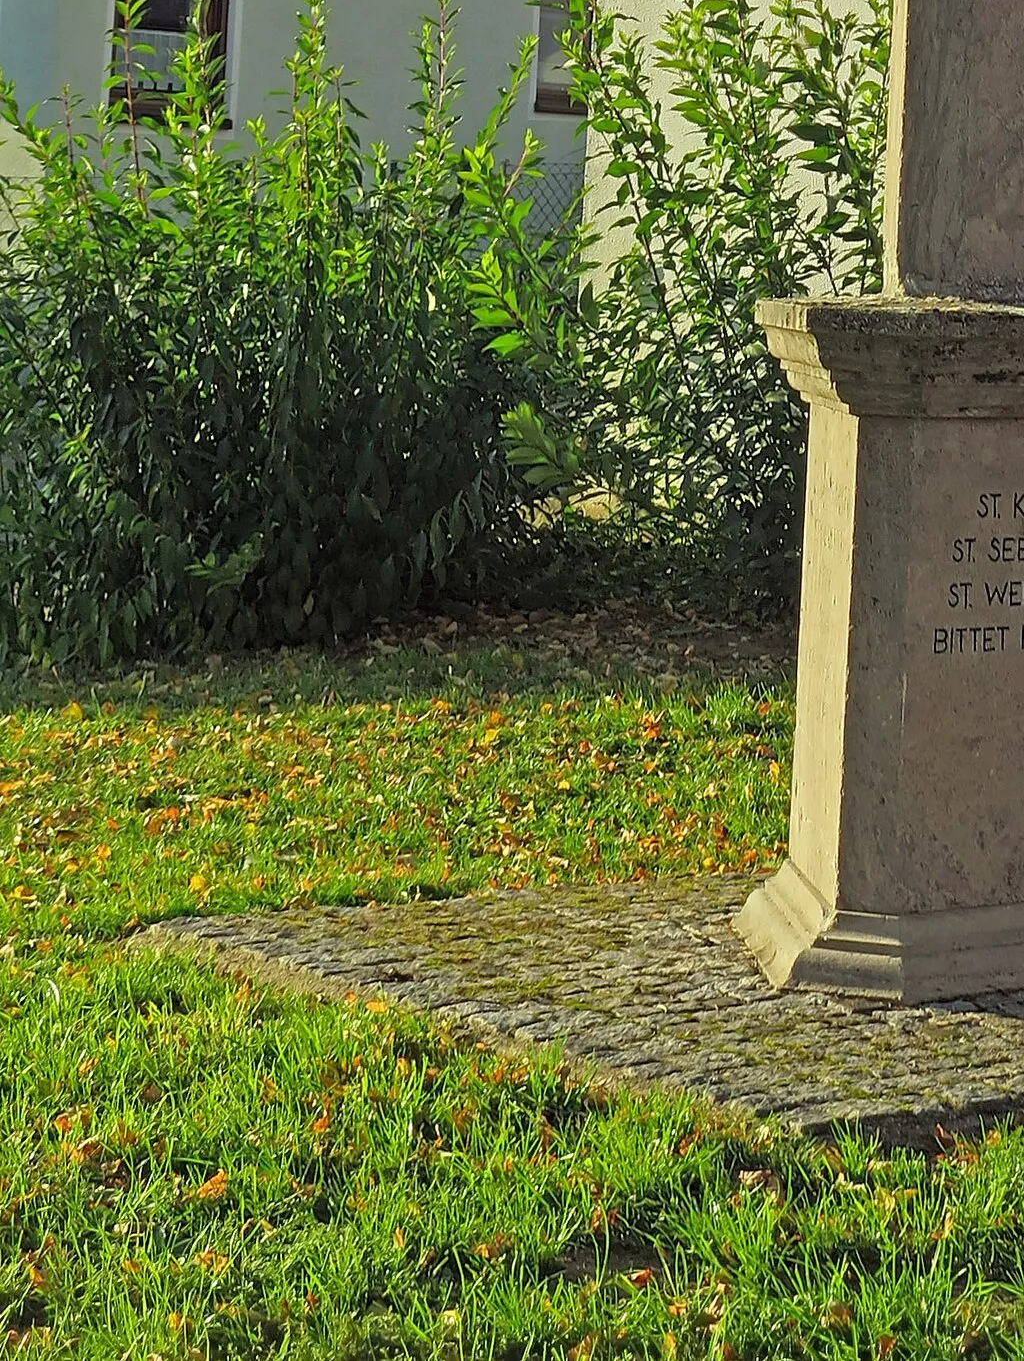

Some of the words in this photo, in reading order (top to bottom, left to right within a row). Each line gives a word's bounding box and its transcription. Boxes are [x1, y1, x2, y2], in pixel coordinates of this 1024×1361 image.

[976, 493, 1002, 519] ST.
[952, 538, 977, 563] ST.
[948, 582, 973, 609] ST.
[933, 626, 1010, 654] BITTET
